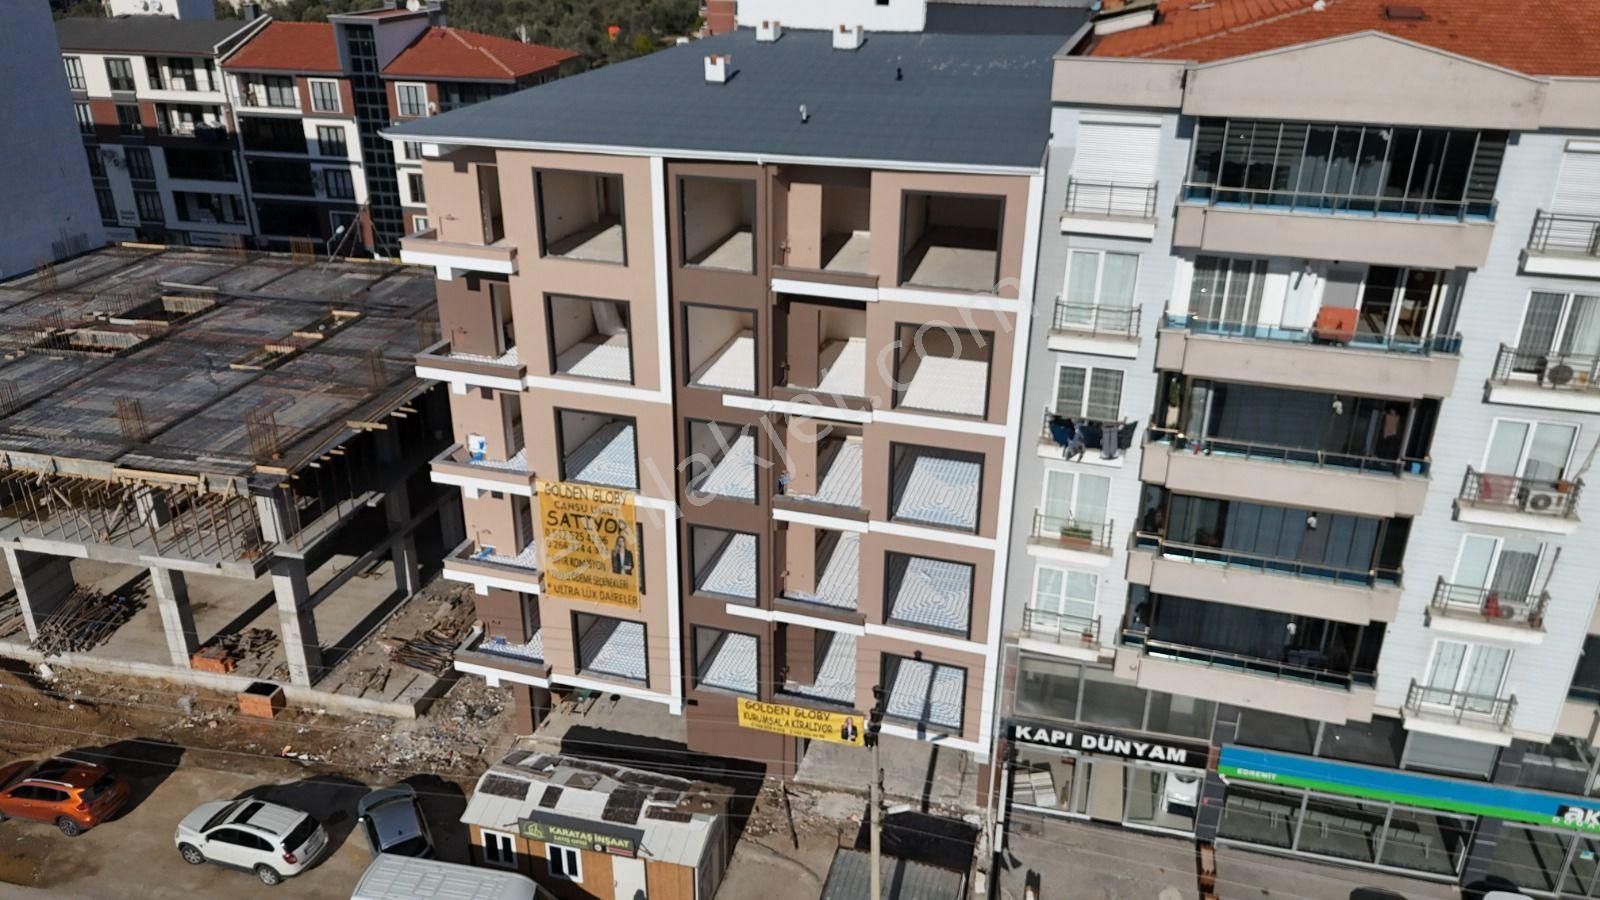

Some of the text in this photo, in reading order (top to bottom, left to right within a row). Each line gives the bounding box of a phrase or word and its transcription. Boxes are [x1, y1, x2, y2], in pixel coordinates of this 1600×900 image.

[544, 482, 589, 500] GOLDEN
[546, 510, 628, 537] SATIYOR
[553, 583, 580, 597] ULTRA
[744, 701, 831, 721] GOLDEN GLOBY
[1015, 724, 1187, 763] KAPI DÜNYAM
